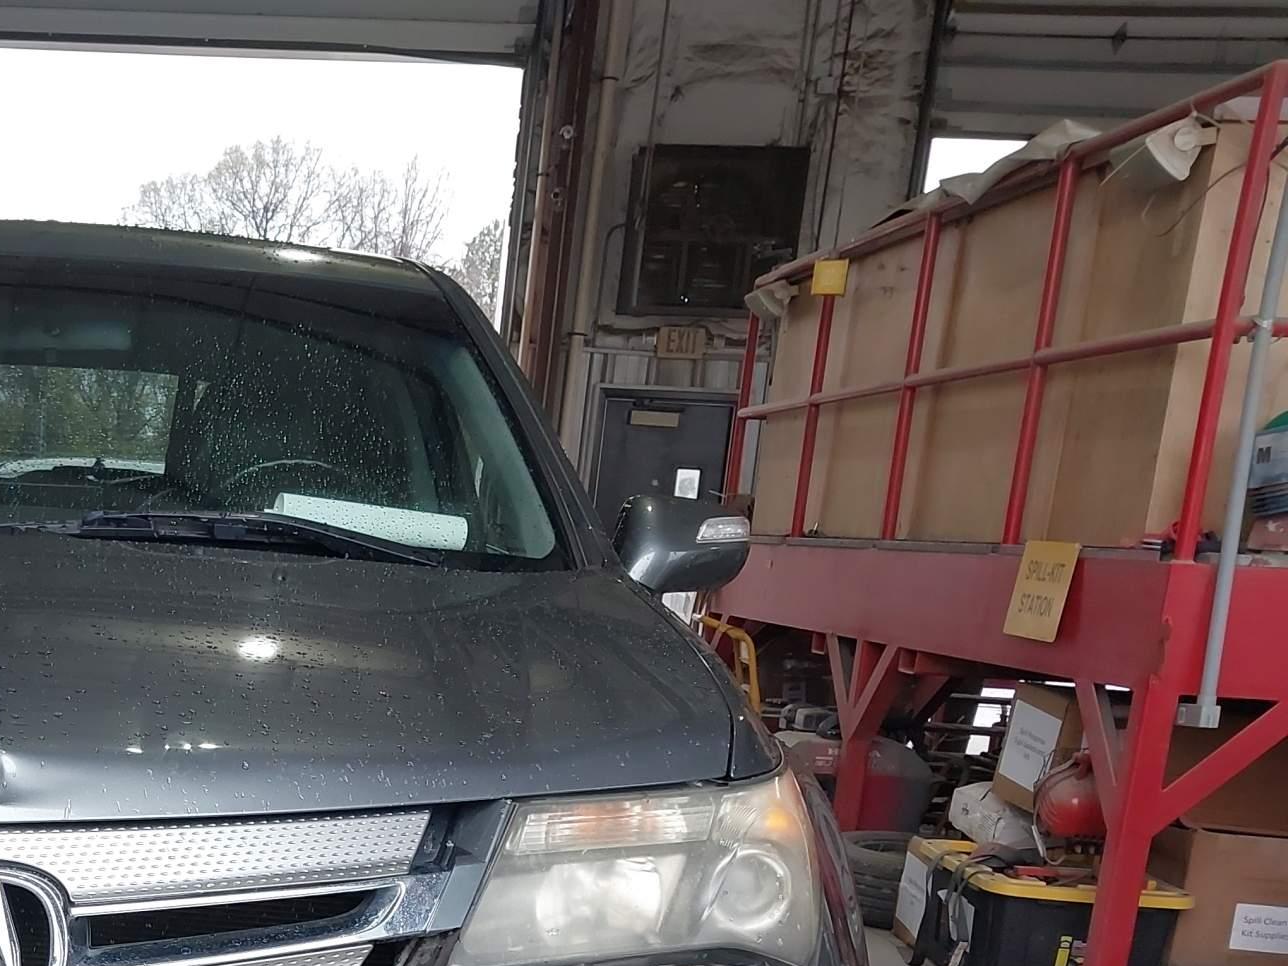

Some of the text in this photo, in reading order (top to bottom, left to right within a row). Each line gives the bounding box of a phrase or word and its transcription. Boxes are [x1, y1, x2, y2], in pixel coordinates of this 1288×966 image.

[666, 328, 697, 354] EXIT
[1025, 559, 1067, 583] SPILL-KIT
[1017, 593, 1055, 617] STATION
[1243, 915, 1288, 927] Spill Clean
[1241, 929, 1254, 938] Kit
